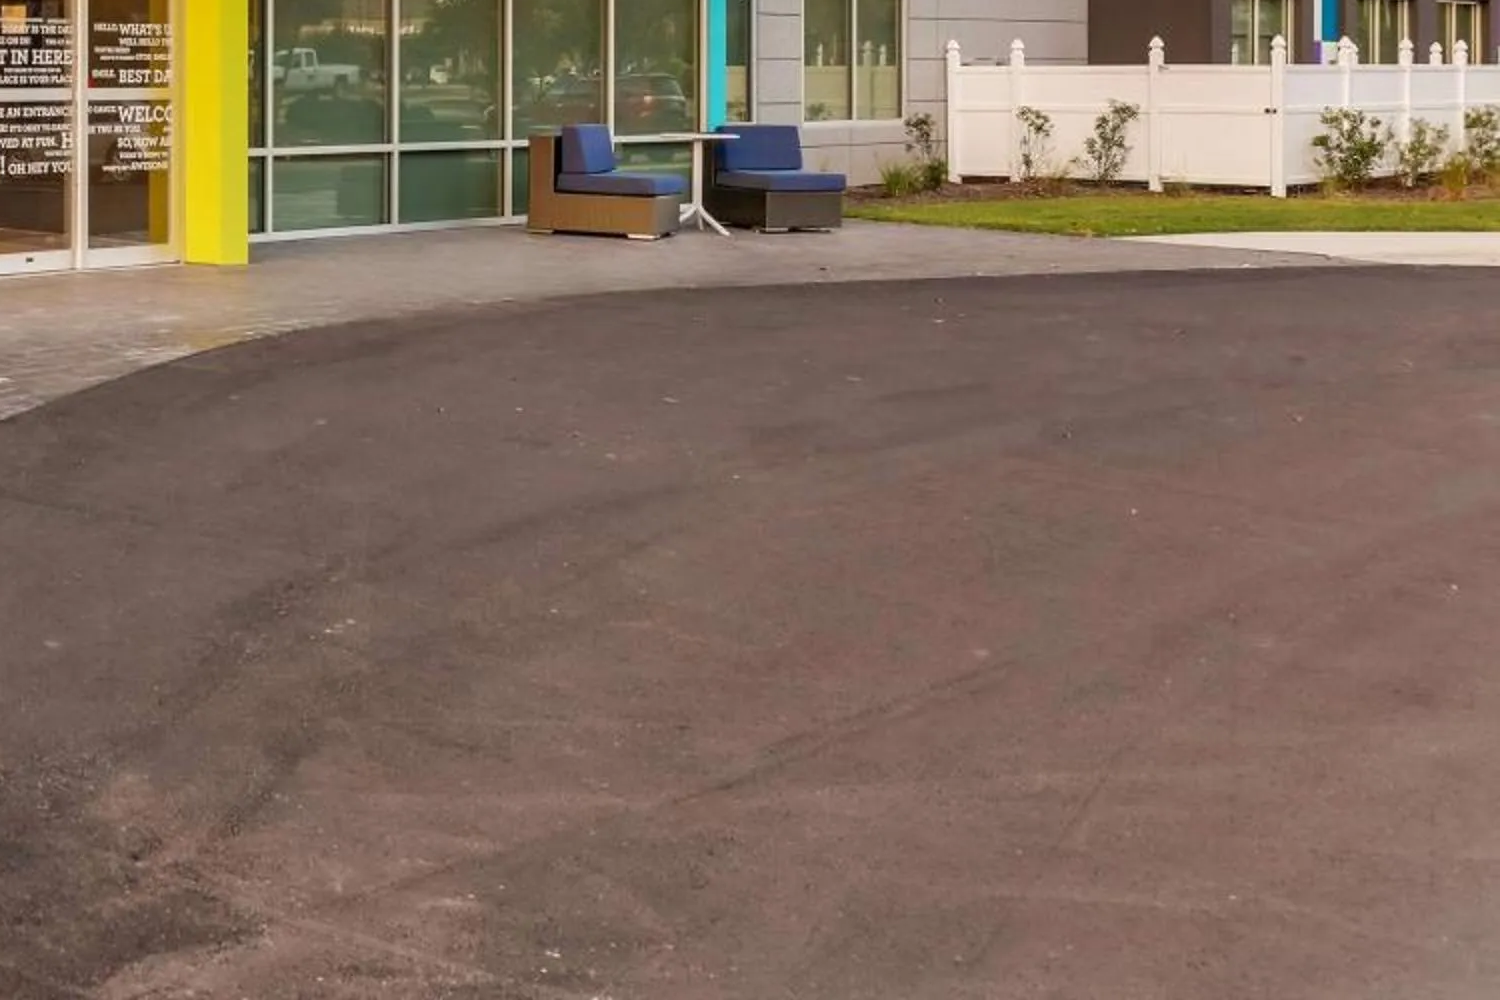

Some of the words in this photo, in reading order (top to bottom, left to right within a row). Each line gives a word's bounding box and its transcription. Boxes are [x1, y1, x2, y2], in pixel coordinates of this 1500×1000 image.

[119, 23, 162, 36] WHAT'S
[10, 49, 29, 65] IN
[31, 49, 74, 65] HERE
[118, 68, 152, 83] BEST
[6, 106, 21, 118] AN
[22, 137, 34, 149] AT
[7, 163, 27, 175] OH
